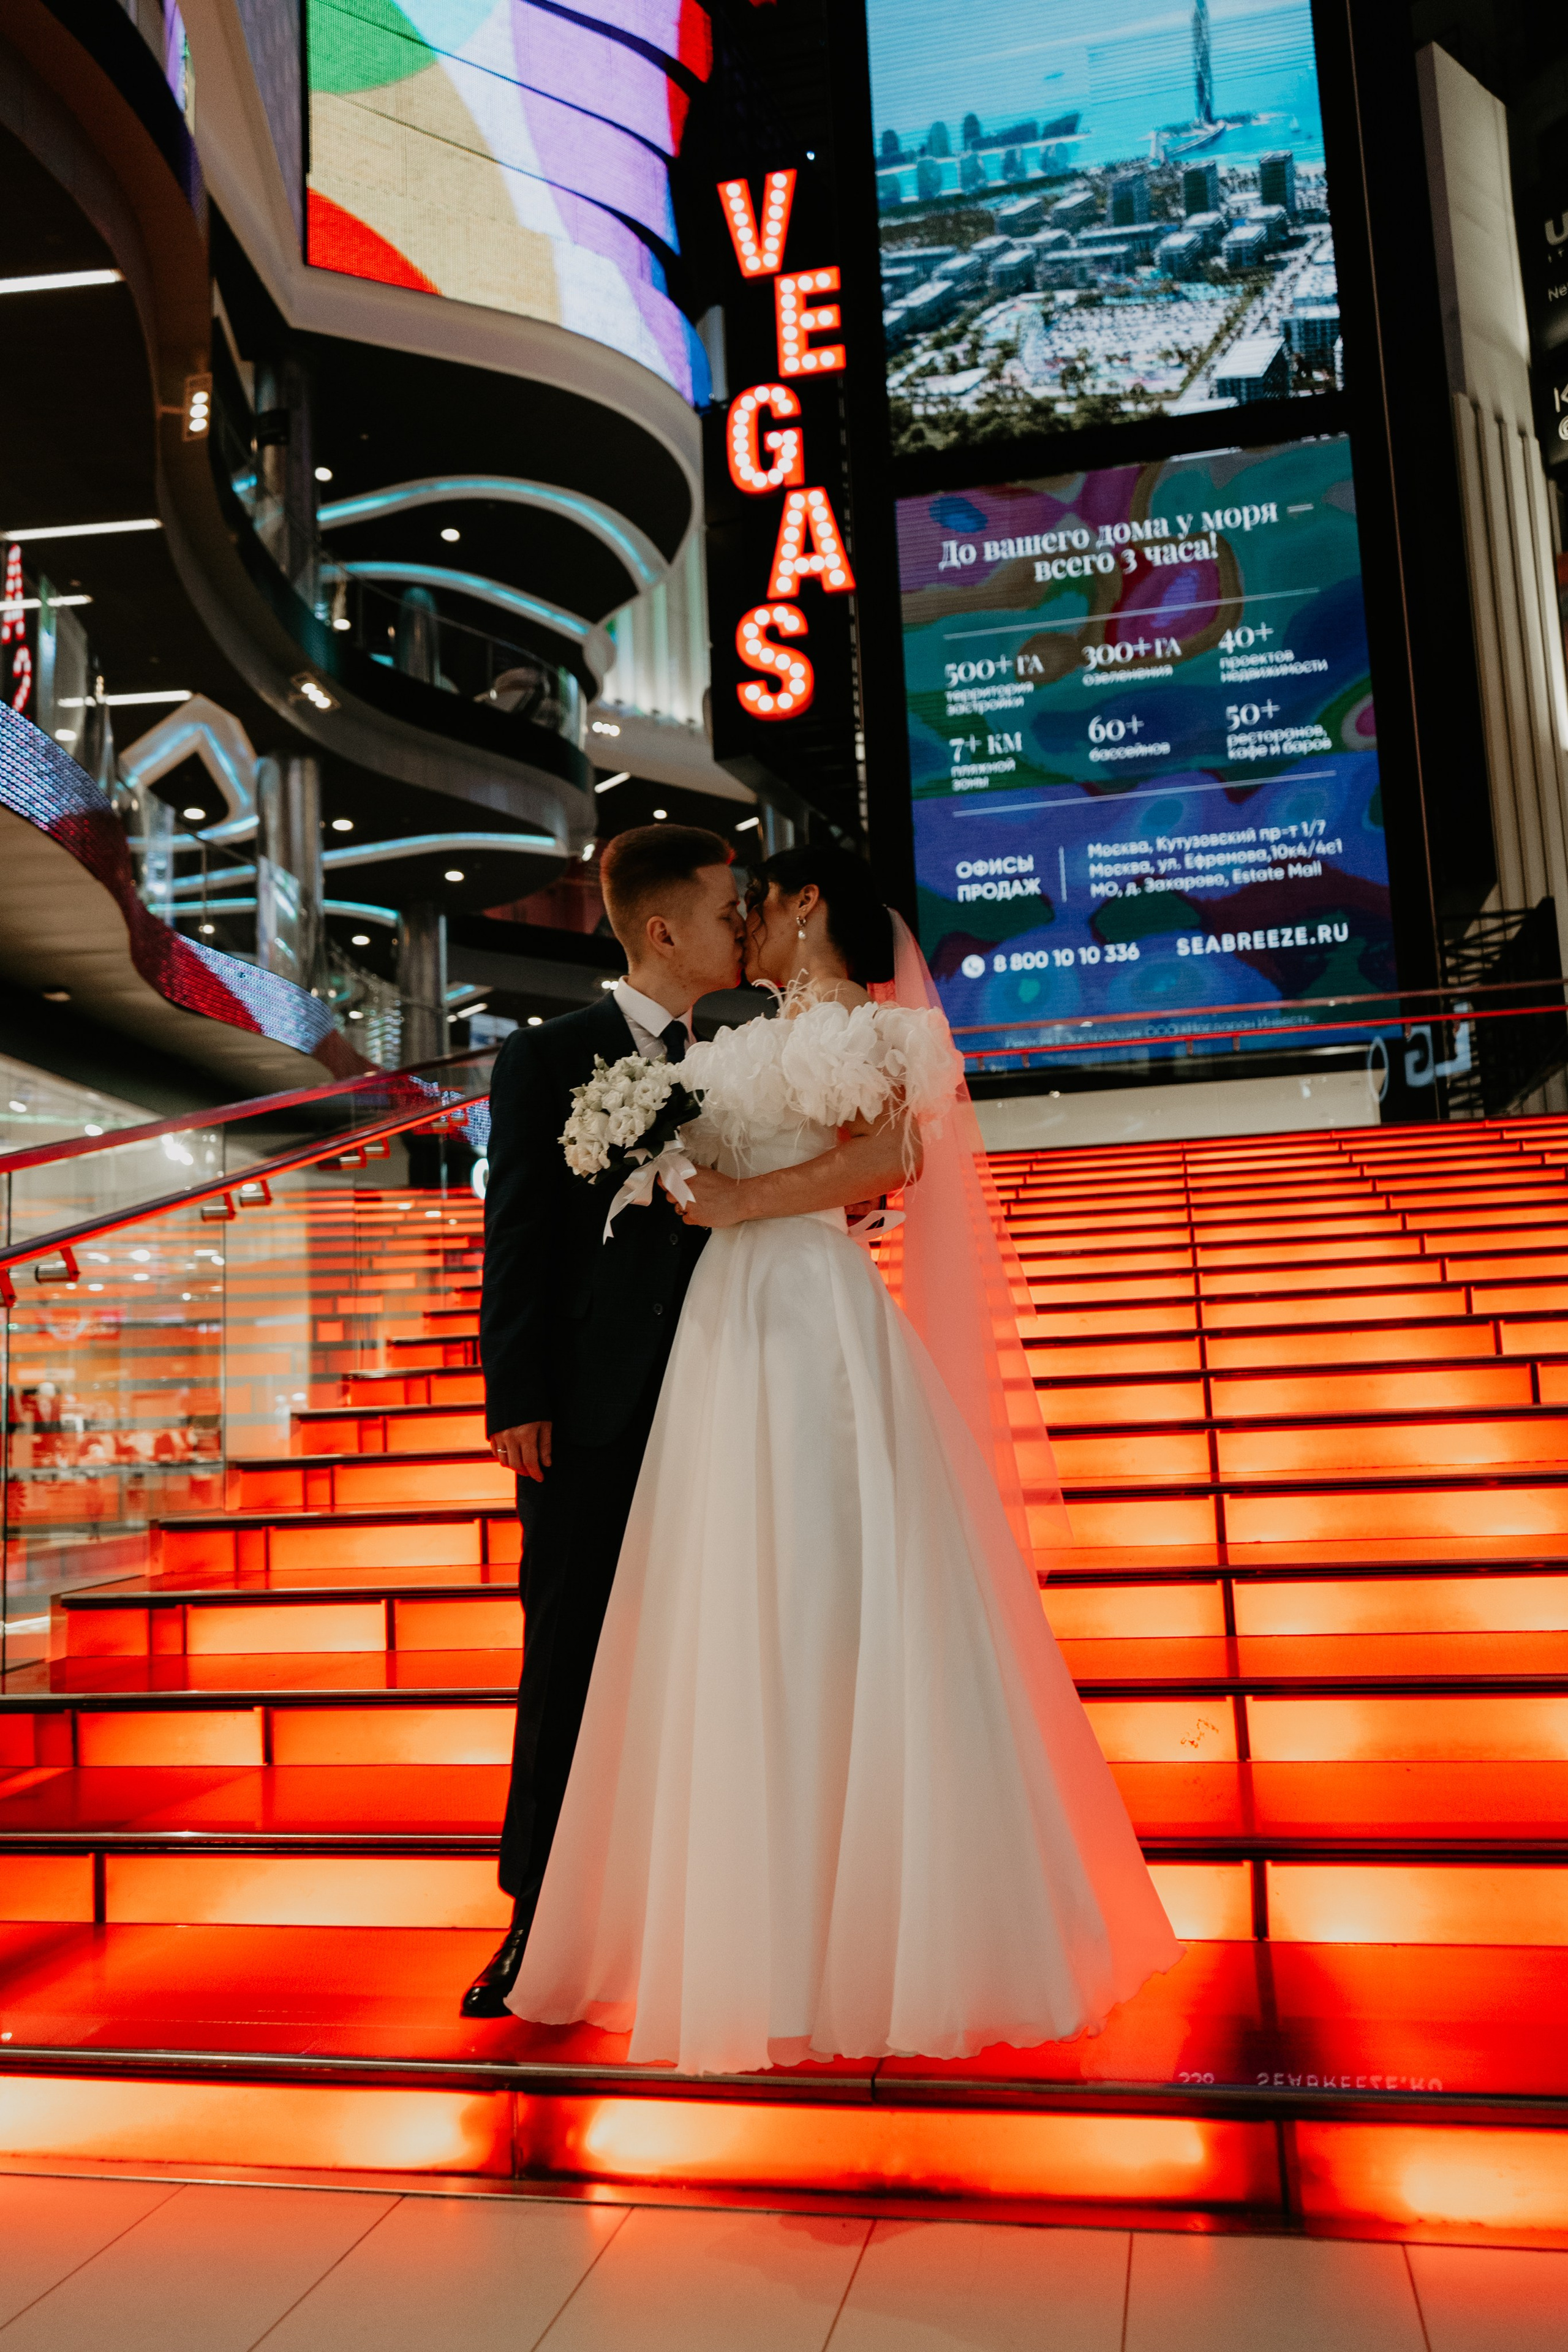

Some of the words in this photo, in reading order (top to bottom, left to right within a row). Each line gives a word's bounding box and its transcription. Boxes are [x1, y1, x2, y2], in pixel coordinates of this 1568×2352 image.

[717, 168, 856, 720] VEGAS
[938, 540, 977, 572] До
[983, 528, 1090, 562] вашего
[1096, 517, 1171, 550] дома
[1176, 513, 1194, 540] у
[1201, 502, 1279, 532] моря
[1035, 552, 1115, 582] всего
[1121, 549, 1138, 575] 3
[1144, 530, 1219, 567] часа!
[1218, 621, 1274, 654] 40+
[1082, 636, 1153, 673] 300+
[1219, 649, 1295, 670] проектов
[944, 654, 1013, 689] 500+
[1088, 714, 1145, 744] 60+
[1226, 698, 1281, 732] 50+
[949, 734, 982, 763] 7+
[1227, 743, 1268, 761] кафе
[1269, 743, 1281, 756] и
[1282, 737, 1332, 756] баров
[1087, 841, 1154, 859] Москва,
[1156, 827, 1256, 854] Кутузовский
[1300, 818, 1326, 838] 1/7
[956, 854, 1035, 880] ОФИСЫ
[1089, 861, 1155, 879] Москва,
[1090, 881, 1123, 898] МО,
[1144, 873, 1229, 893] Захарово,
[1232, 866, 1285, 884] Estate
[1287, 860, 1322, 879] Mall
[957, 876, 1042, 903] ПРОДАЖ
[1176, 922, 1349, 956] SEABREEZE.RU
[993, 954, 1007, 973] 8
[1010, 950, 1049, 971] 800
[1052, 948, 1075, 967] 10
[1077, 946, 1101, 965] 10
[1104, 942, 1140, 963] 336
